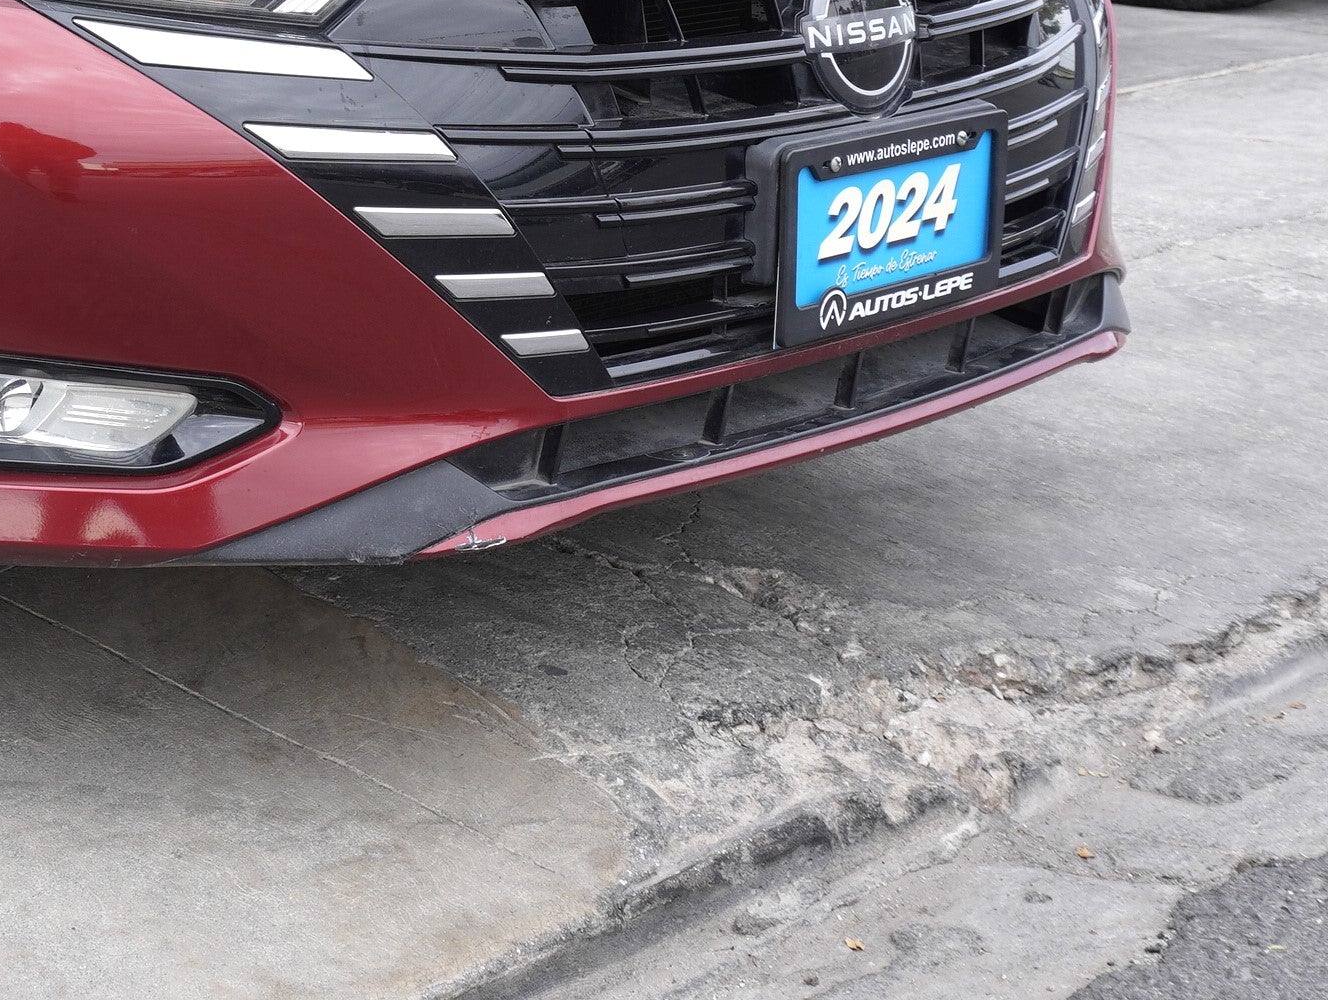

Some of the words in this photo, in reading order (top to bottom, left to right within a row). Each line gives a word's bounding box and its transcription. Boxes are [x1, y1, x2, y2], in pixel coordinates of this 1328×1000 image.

[807, 13, 916, 49] NISSAN
[846, 132, 956, 167] www.autoslepe.com
[817, 163, 961, 261] 2024
[836, 264, 849, 288] Es
[852, 261, 884, 283] Tiempo
[885, 257, 898, 273] de
[898, 249, 938, 272] Estrenar
